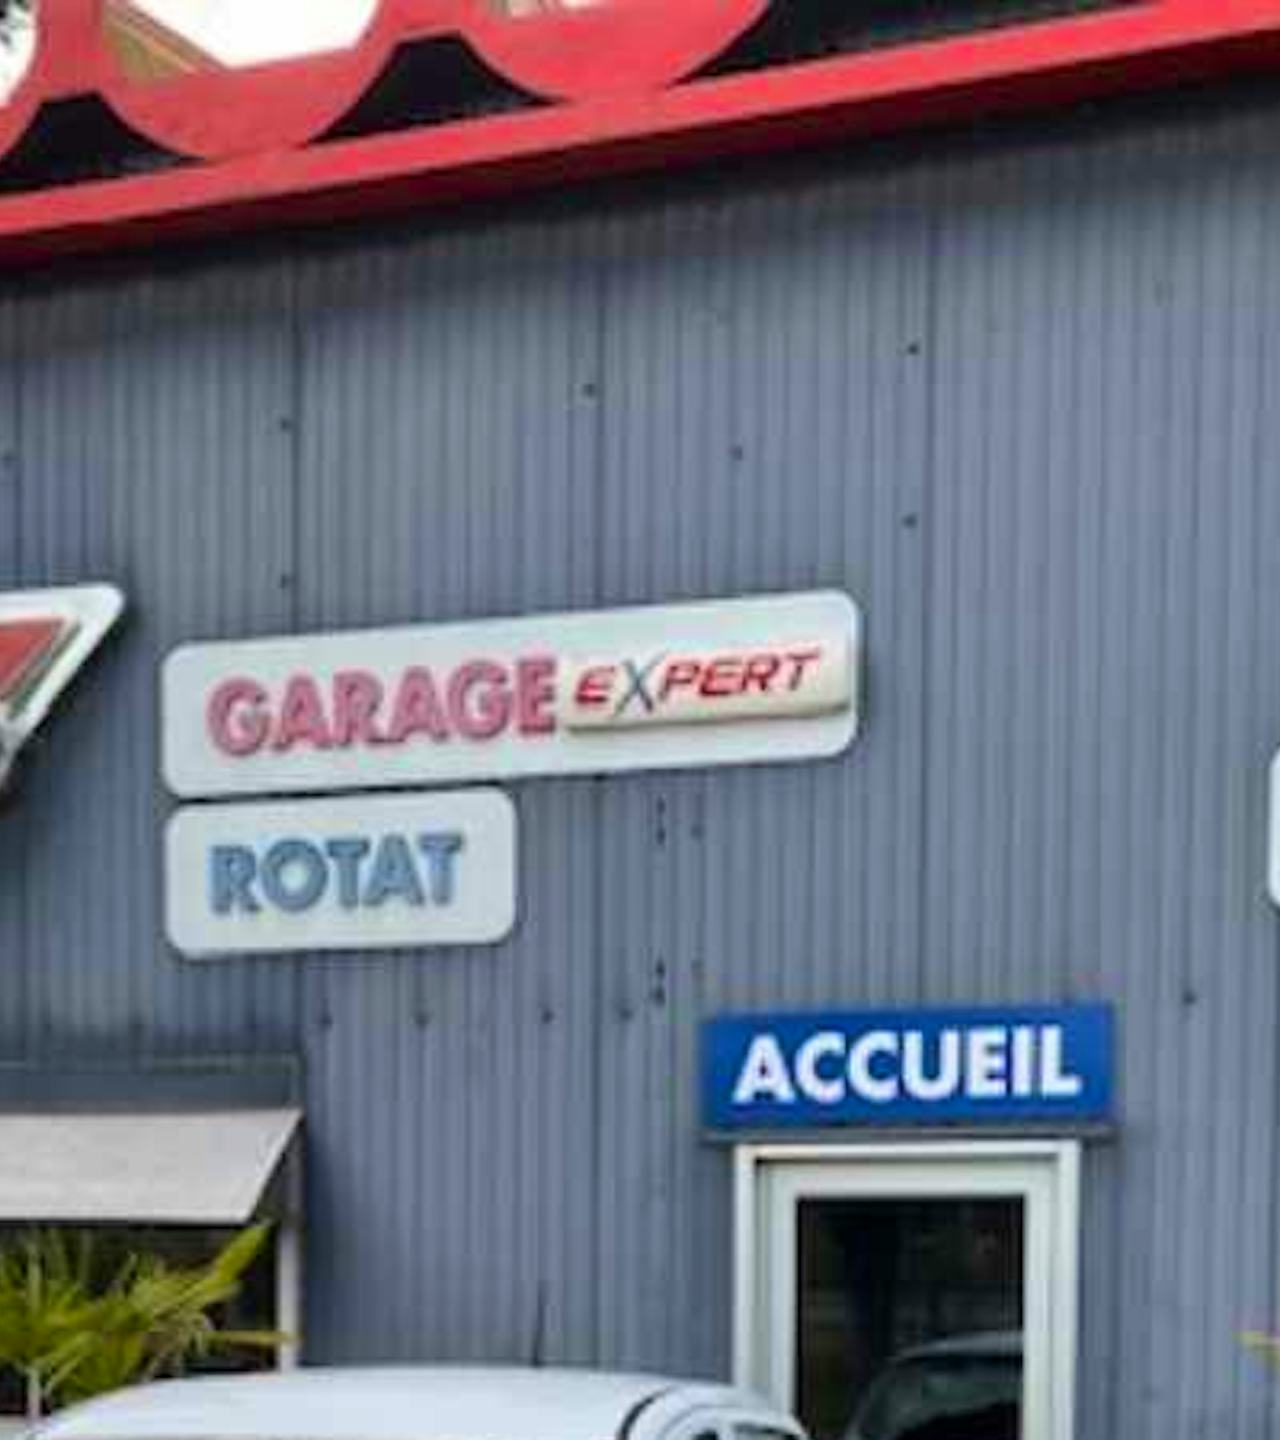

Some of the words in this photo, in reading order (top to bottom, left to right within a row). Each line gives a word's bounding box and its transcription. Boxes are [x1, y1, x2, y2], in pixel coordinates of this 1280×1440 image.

[205, 654, 557, 758] GARAGE
[208, 832, 466, 914] ROTAT
[731, 1024, 1084, 1104] ACCUEIL
